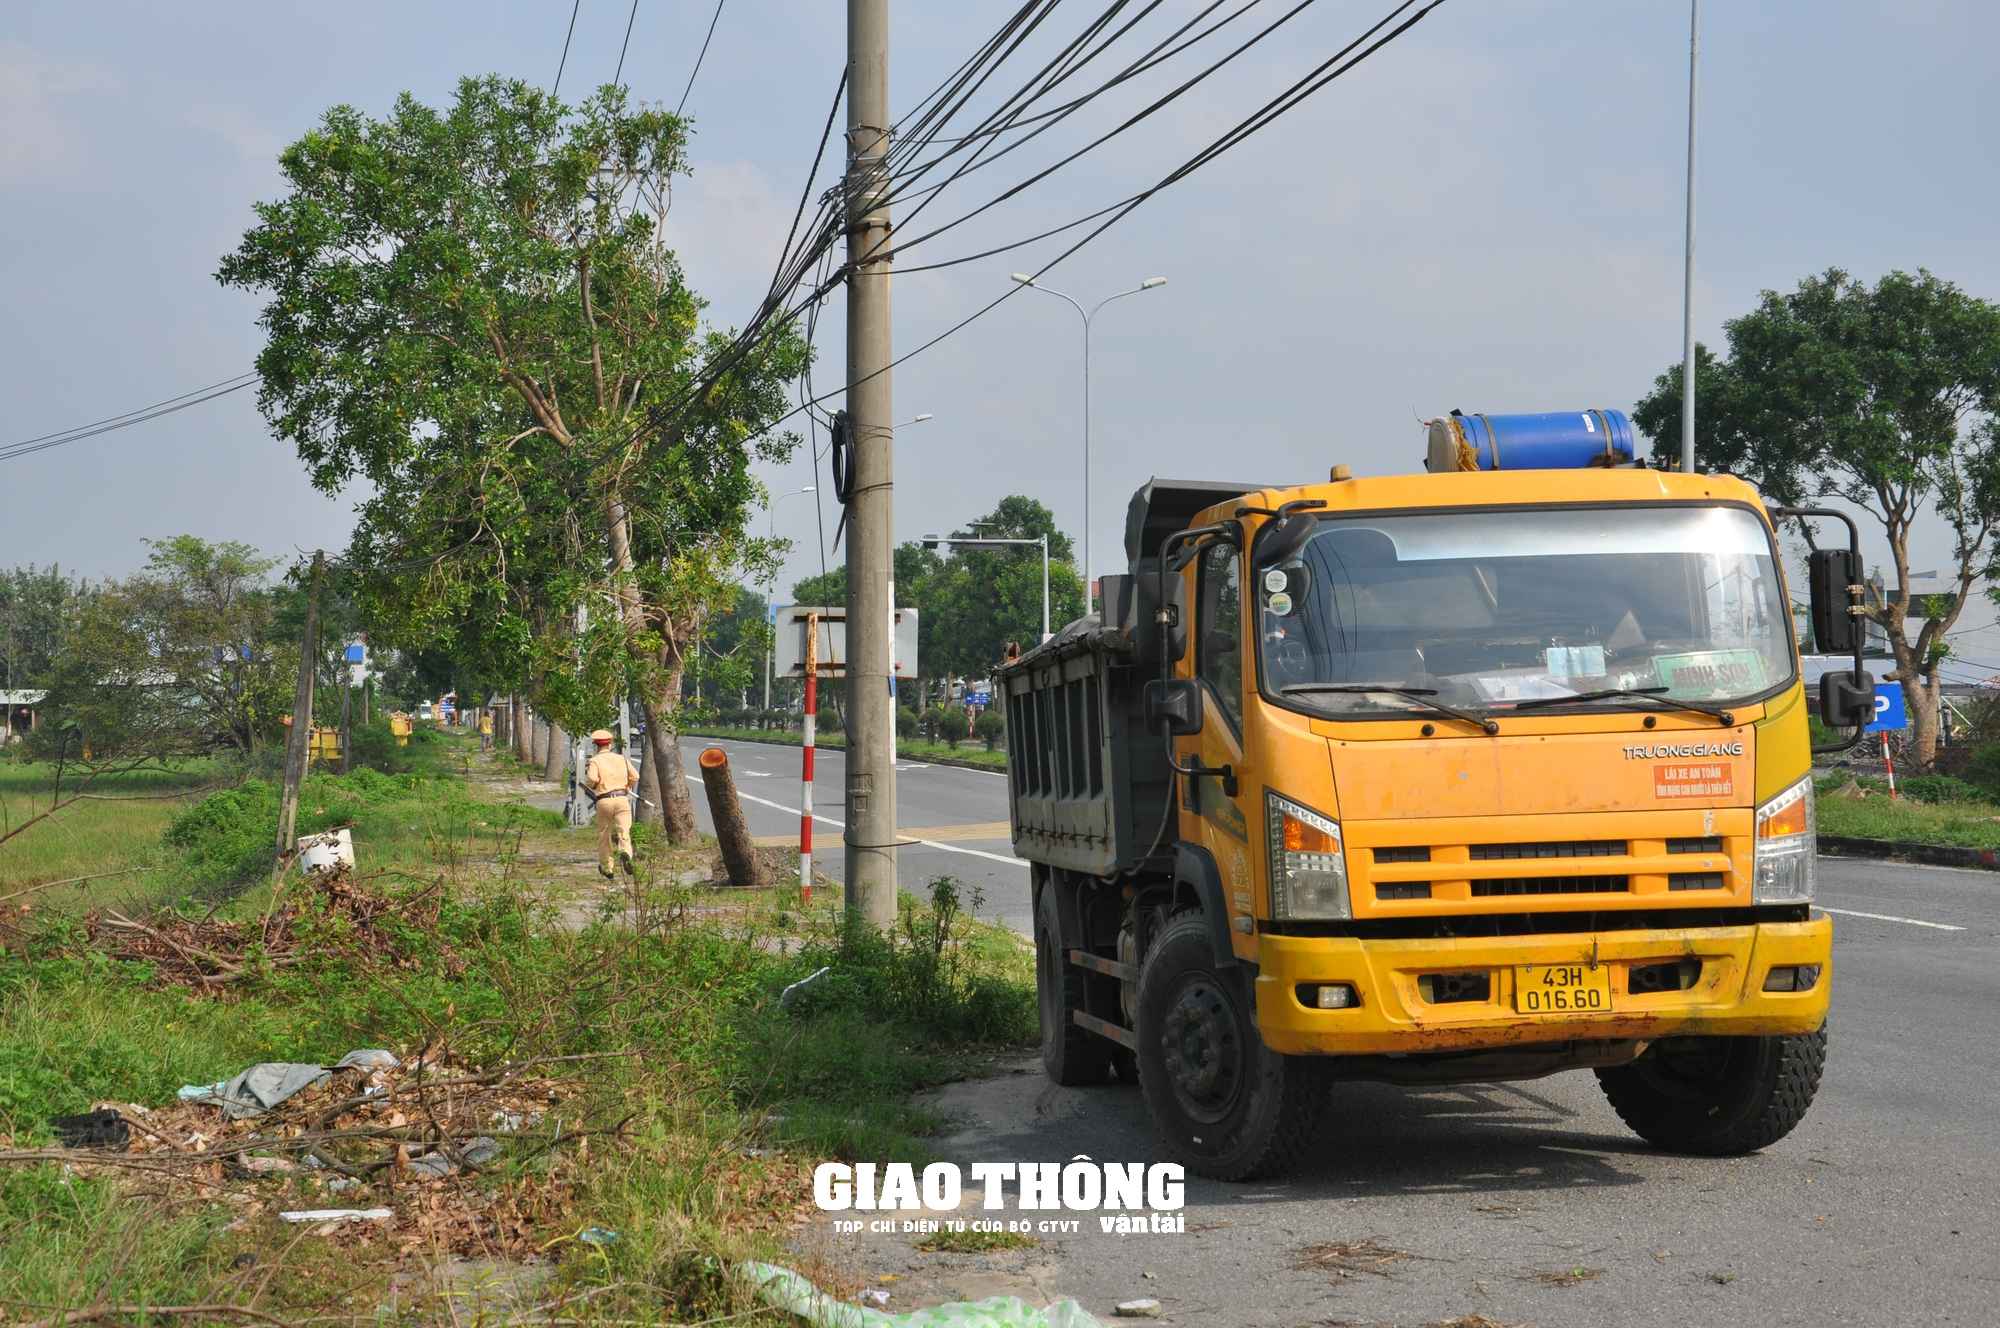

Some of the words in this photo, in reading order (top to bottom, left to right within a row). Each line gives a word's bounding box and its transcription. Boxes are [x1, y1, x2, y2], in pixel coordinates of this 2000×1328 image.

[1671, 665, 1716, 688] MINH
[1874, 695, 1890, 721] P
[1664, 766, 1677, 780] LÁI
[1678, 768, 1688, 779] XE
[1689, 767, 1700, 779] AN
[1701, 765, 1722, 778] TOÀN
[1543, 967, 1582, 987] 43H
[1527, 989, 1600, 1010] 016.60
